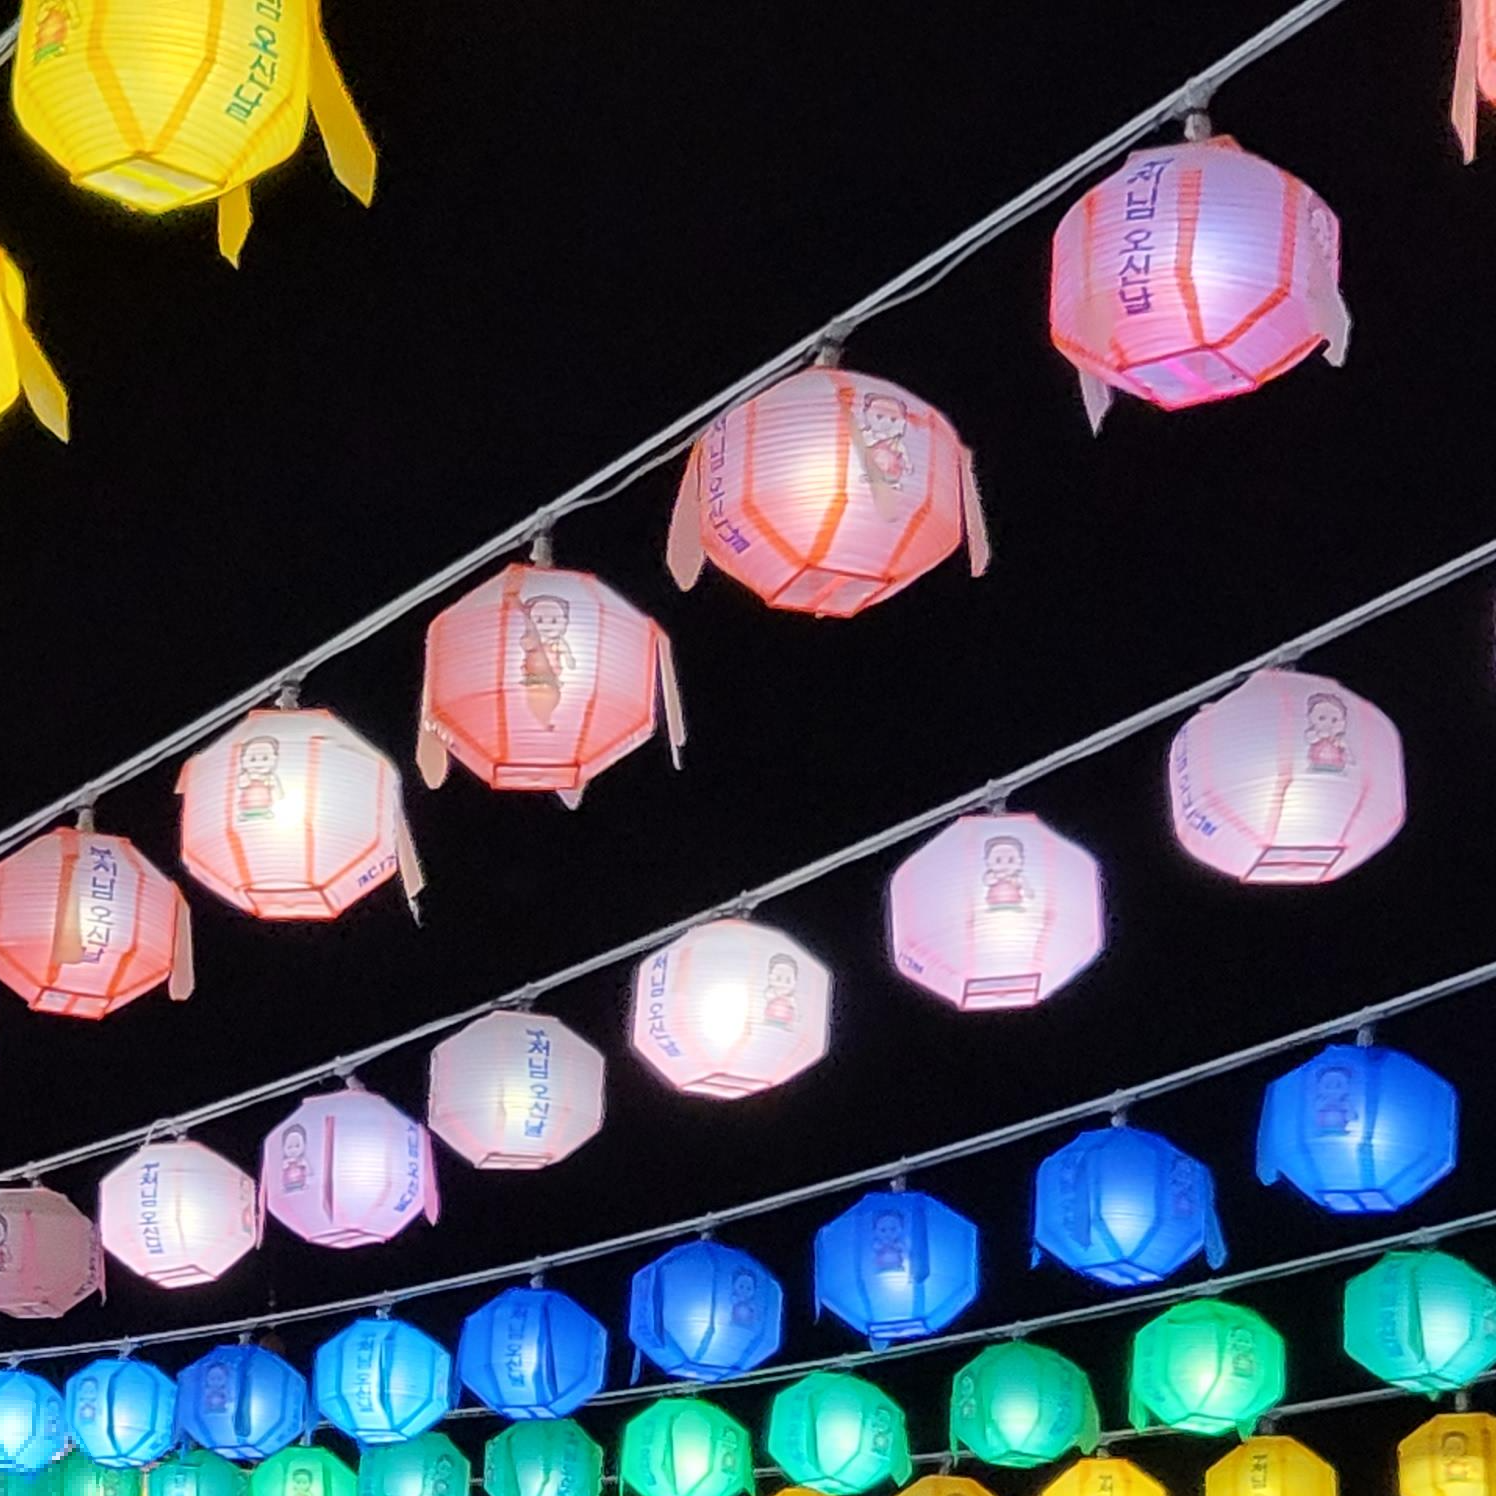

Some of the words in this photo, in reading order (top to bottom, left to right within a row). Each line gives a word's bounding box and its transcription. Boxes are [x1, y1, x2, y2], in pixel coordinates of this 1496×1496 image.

[225, 25, 279, 125] 오신날
[1118, 229, 1156, 317] 오신날
[523, 1083, 552, 1138] 오신날
[139, 1209, 166, 1255] 오신날
